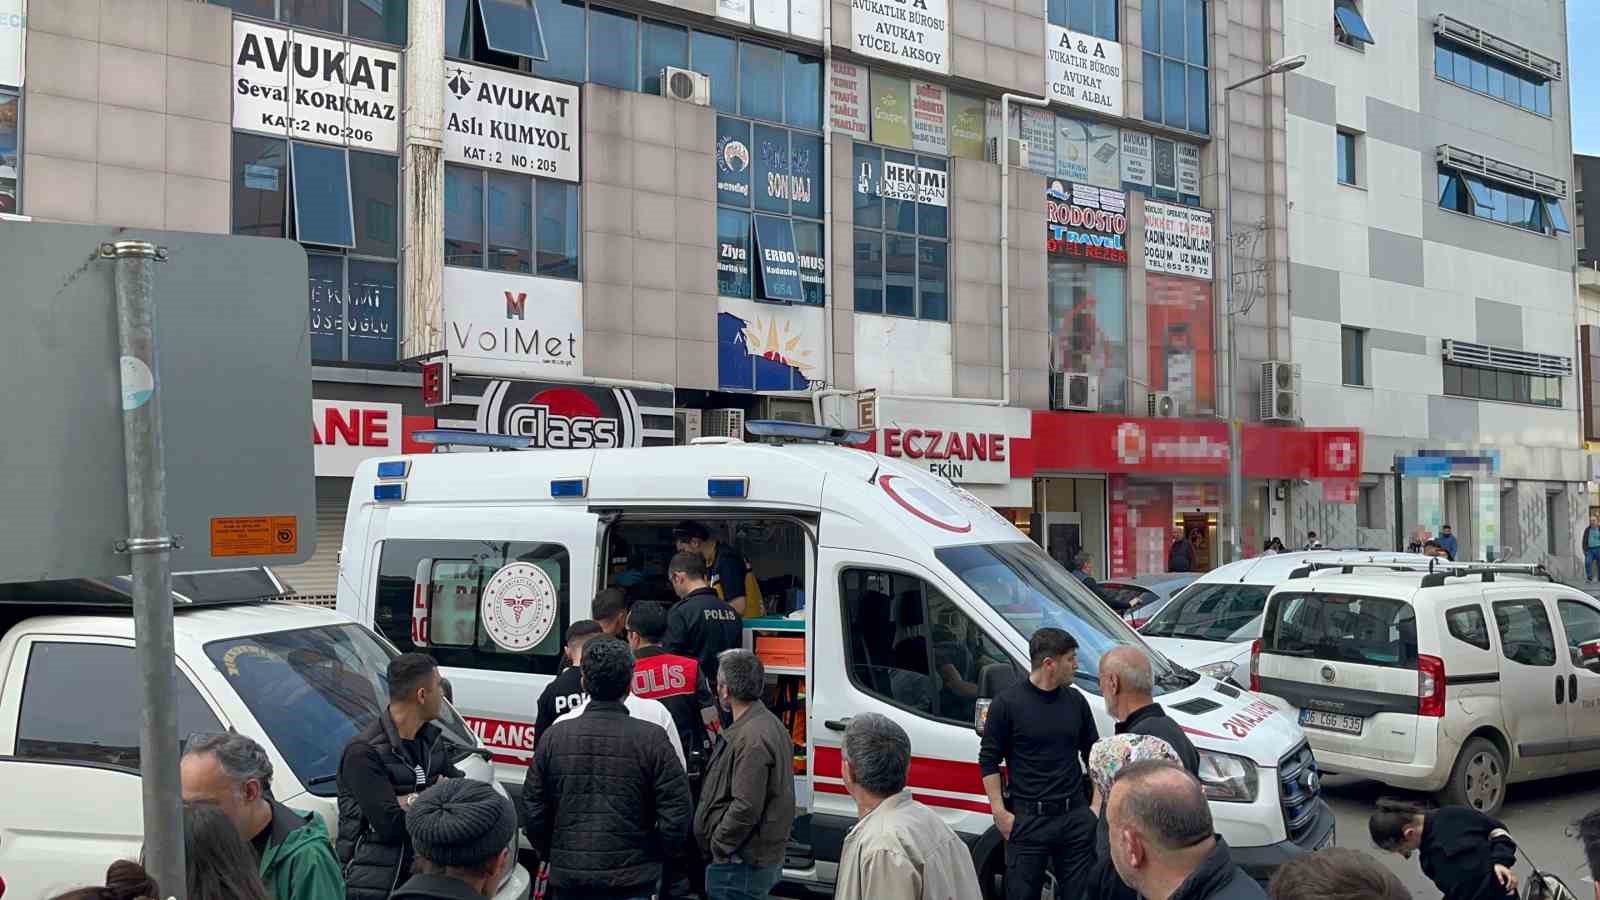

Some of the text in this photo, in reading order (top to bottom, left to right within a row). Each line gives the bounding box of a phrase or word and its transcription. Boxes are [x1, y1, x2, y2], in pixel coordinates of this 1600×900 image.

[875, 22, 925, 44] AVUKAT
[1058, 32, 1072, 50] A
[1092, 42, 1106, 60] A
[237, 32, 397, 93] AVUKAT
[857, 33, 942, 65] YÜCEL AKSOY
[1047, 48, 1088, 70] VUKATLIK
[1052, 82, 1076, 98] CEM
[1063, 69, 1103, 90] AVUKAT
[237, 78, 396, 121] Seval KORKMAZ
[476, 82, 570, 118] AVUKAT
[261, 113, 374, 142] KAT:2 NO:206
[446, 112, 571, 152] Aslı KUMYOL
[463, 145, 486, 161] KAT
[495, 151, 502, 164] 2
[511, 153, 528, 168] NO
[537, 158, 557, 173] 205
[887, 165, 946, 189] HEKİMİ
[1047, 200, 1128, 235] RODOSTO
[452, 320, 577, 359] VolMet
[313, 407, 389, 447] NE
[883, 428, 1005, 462] ECZANE
[631, 663, 686, 694] OLİS
